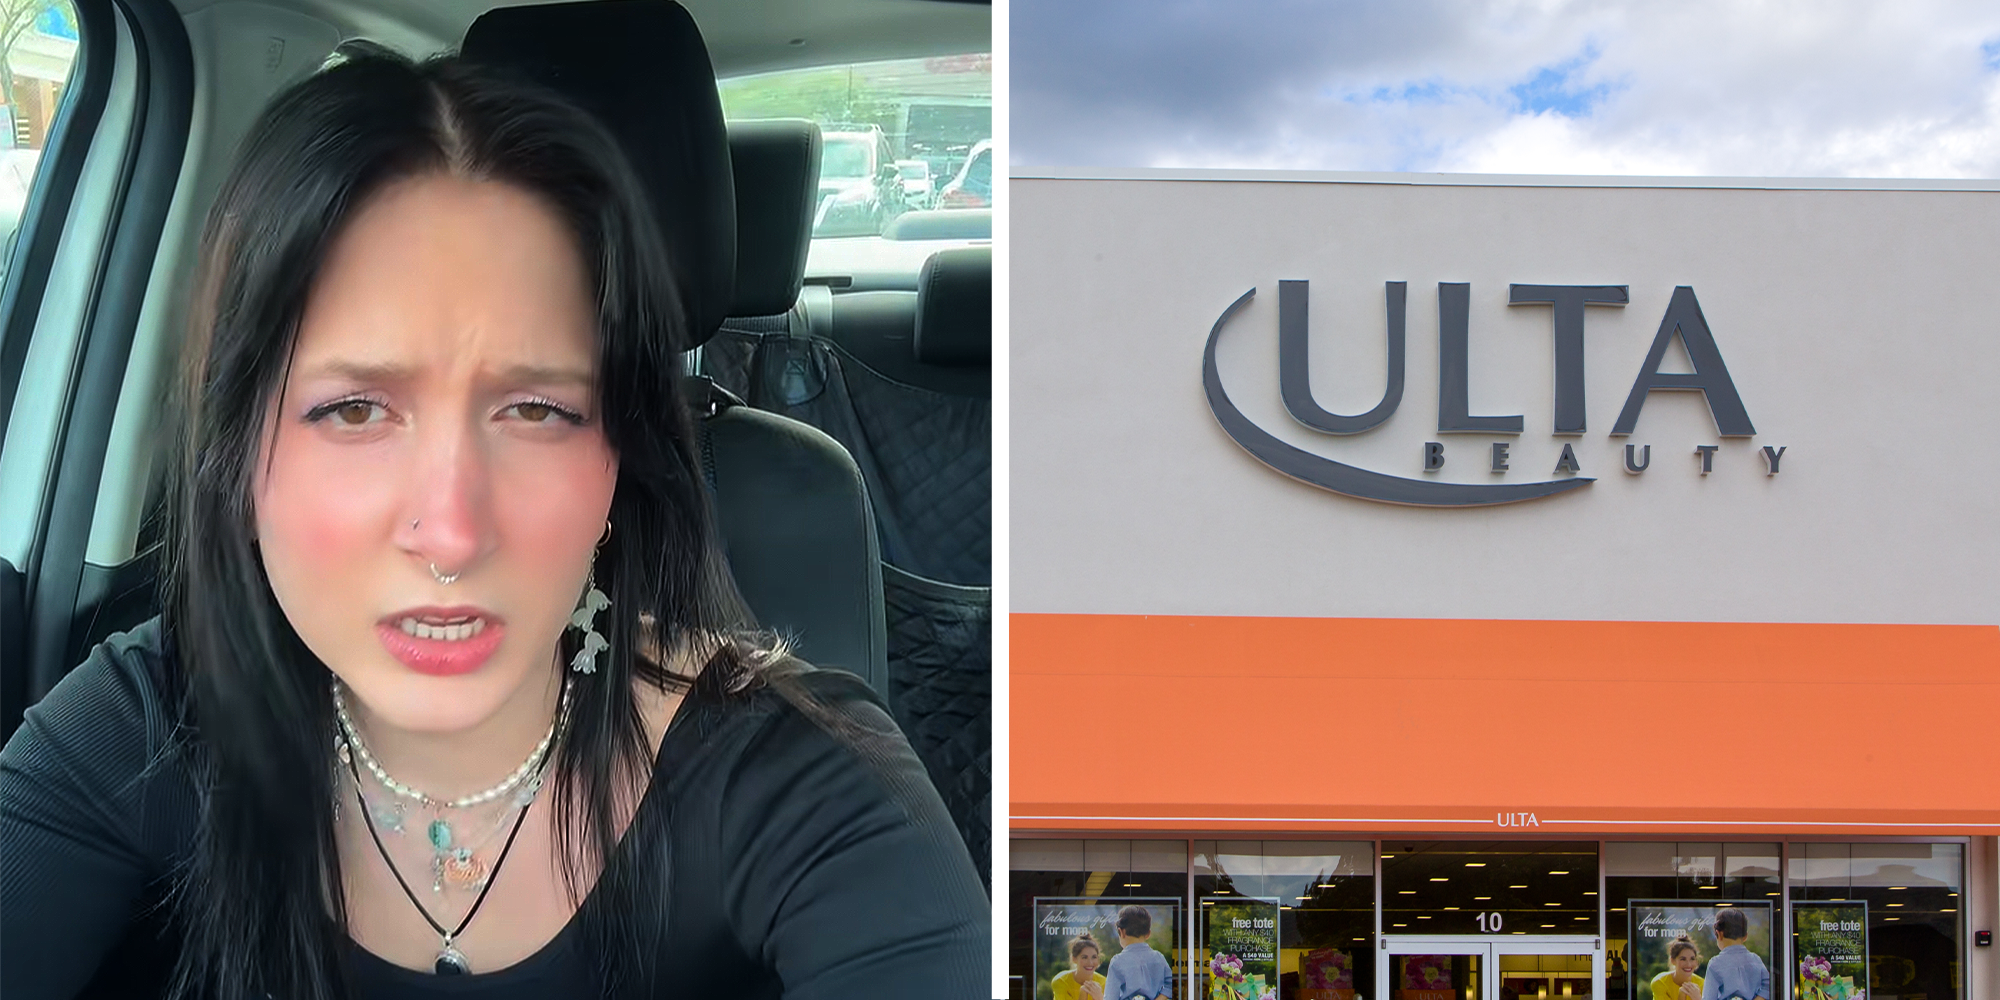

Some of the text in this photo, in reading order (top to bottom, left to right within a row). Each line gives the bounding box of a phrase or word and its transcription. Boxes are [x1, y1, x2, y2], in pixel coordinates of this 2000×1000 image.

[1278, 279, 1757, 438] ULTA
[1423, 441, 1787, 479] BEAUTY
[1497, 812, 1539, 828] ULTA
[1039, 910, 1091, 929] fabulous
[1232, 916, 1274, 929] free tote
[1476, 911, 1503, 933] 10
[1638, 912, 1689, 931] fabulous
[1820, 920, 1861, 931] free tote
[1045, 924, 1089, 936] for mom
[1222, 929, 1242, 937] WITH
[1644, 925, 1687, 938] for mom
[1227, 936, 1275, 945] FRAGRANCE
[1815, 939, 1862, 947] FRAGRANCE
